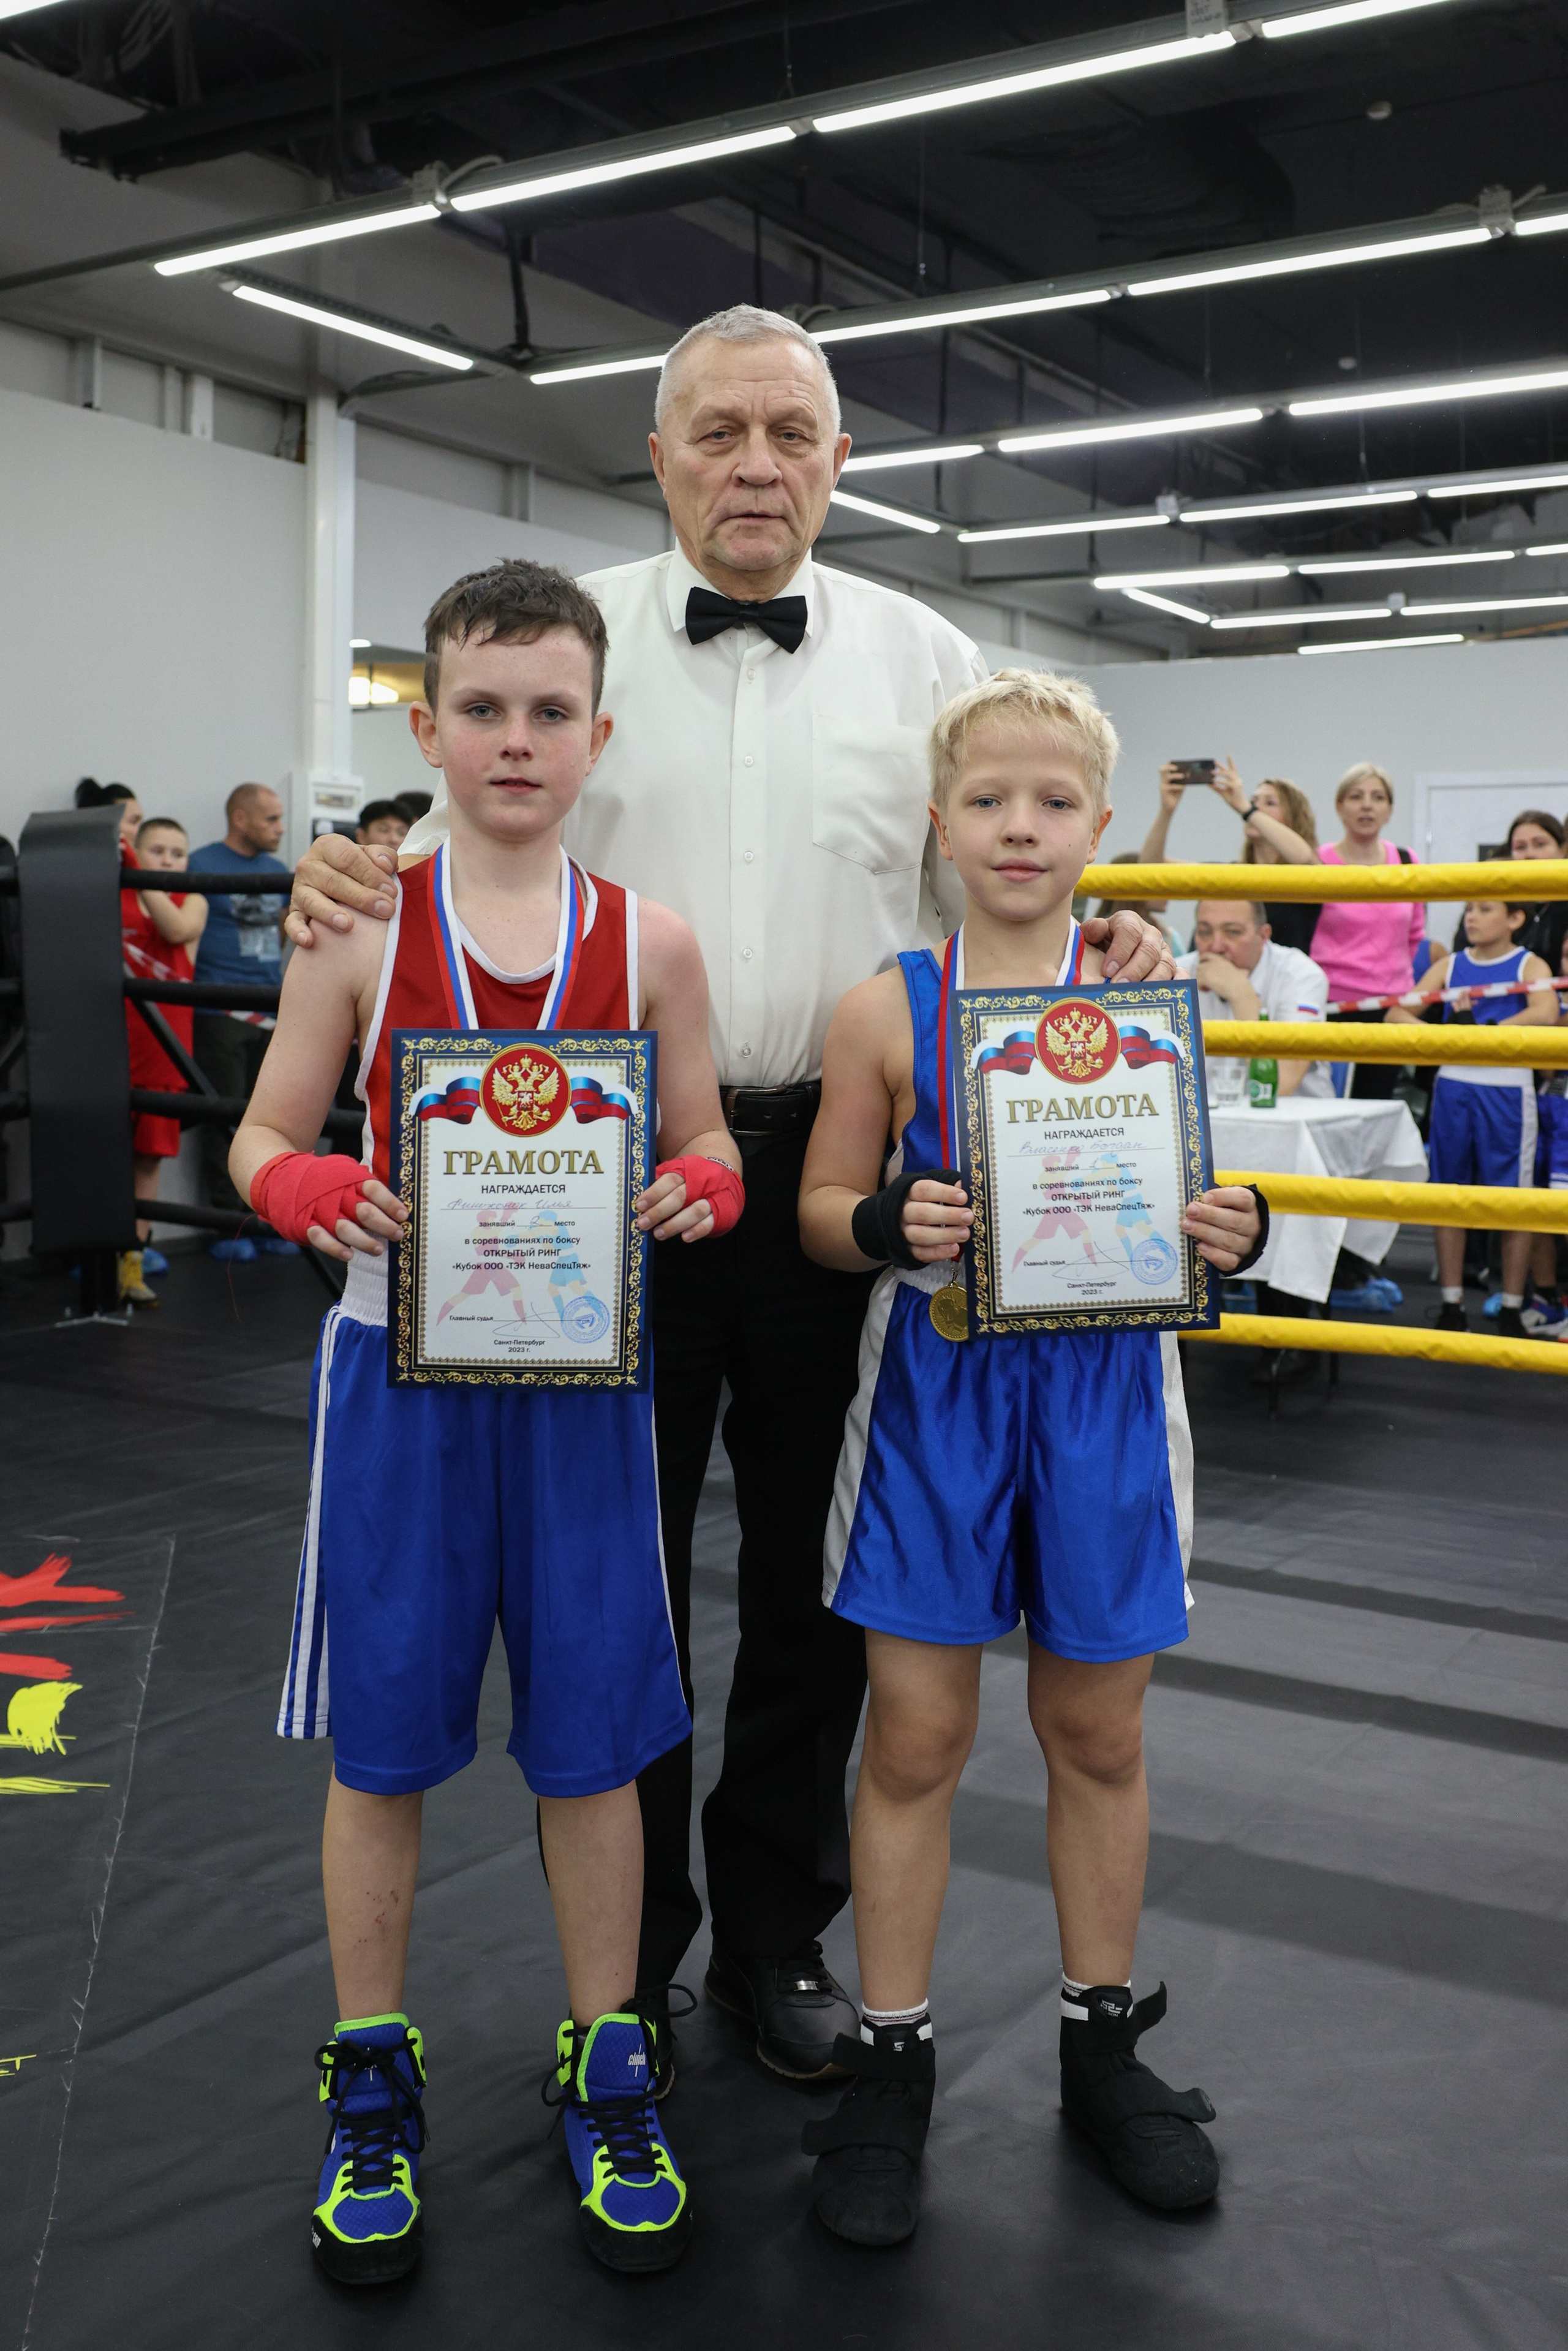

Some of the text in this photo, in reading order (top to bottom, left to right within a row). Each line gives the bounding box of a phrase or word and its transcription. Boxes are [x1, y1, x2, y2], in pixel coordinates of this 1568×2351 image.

[1006, 1093, 1159, 1123] ГРАМОТА
[1044, 1127, 1125, 1140] НАГРАЖДАЕТСЯ
[443, 1149, 605, 1175] ГРАМОТА
[481, 1184, 566, 1195] НАГРАЖДАЕТСЯ
[1039, 1180, 1106, 1191] соревнованиях
[1119, 1177, 1143, 1187] боксу
[1050, 1190, 1125, 1202] ОТКРЫТЫЙ РИНГ
[1053, 1206, 1071, 1215] ООО
[529, 1215, 544, 1226] 2
[472, 1237, 540, 1246] соревнованиях
[556, 1236, 581, 1246] боксу
[483, 1247, 562, 1257] ОТКРЫТЫЙ РИНГ
